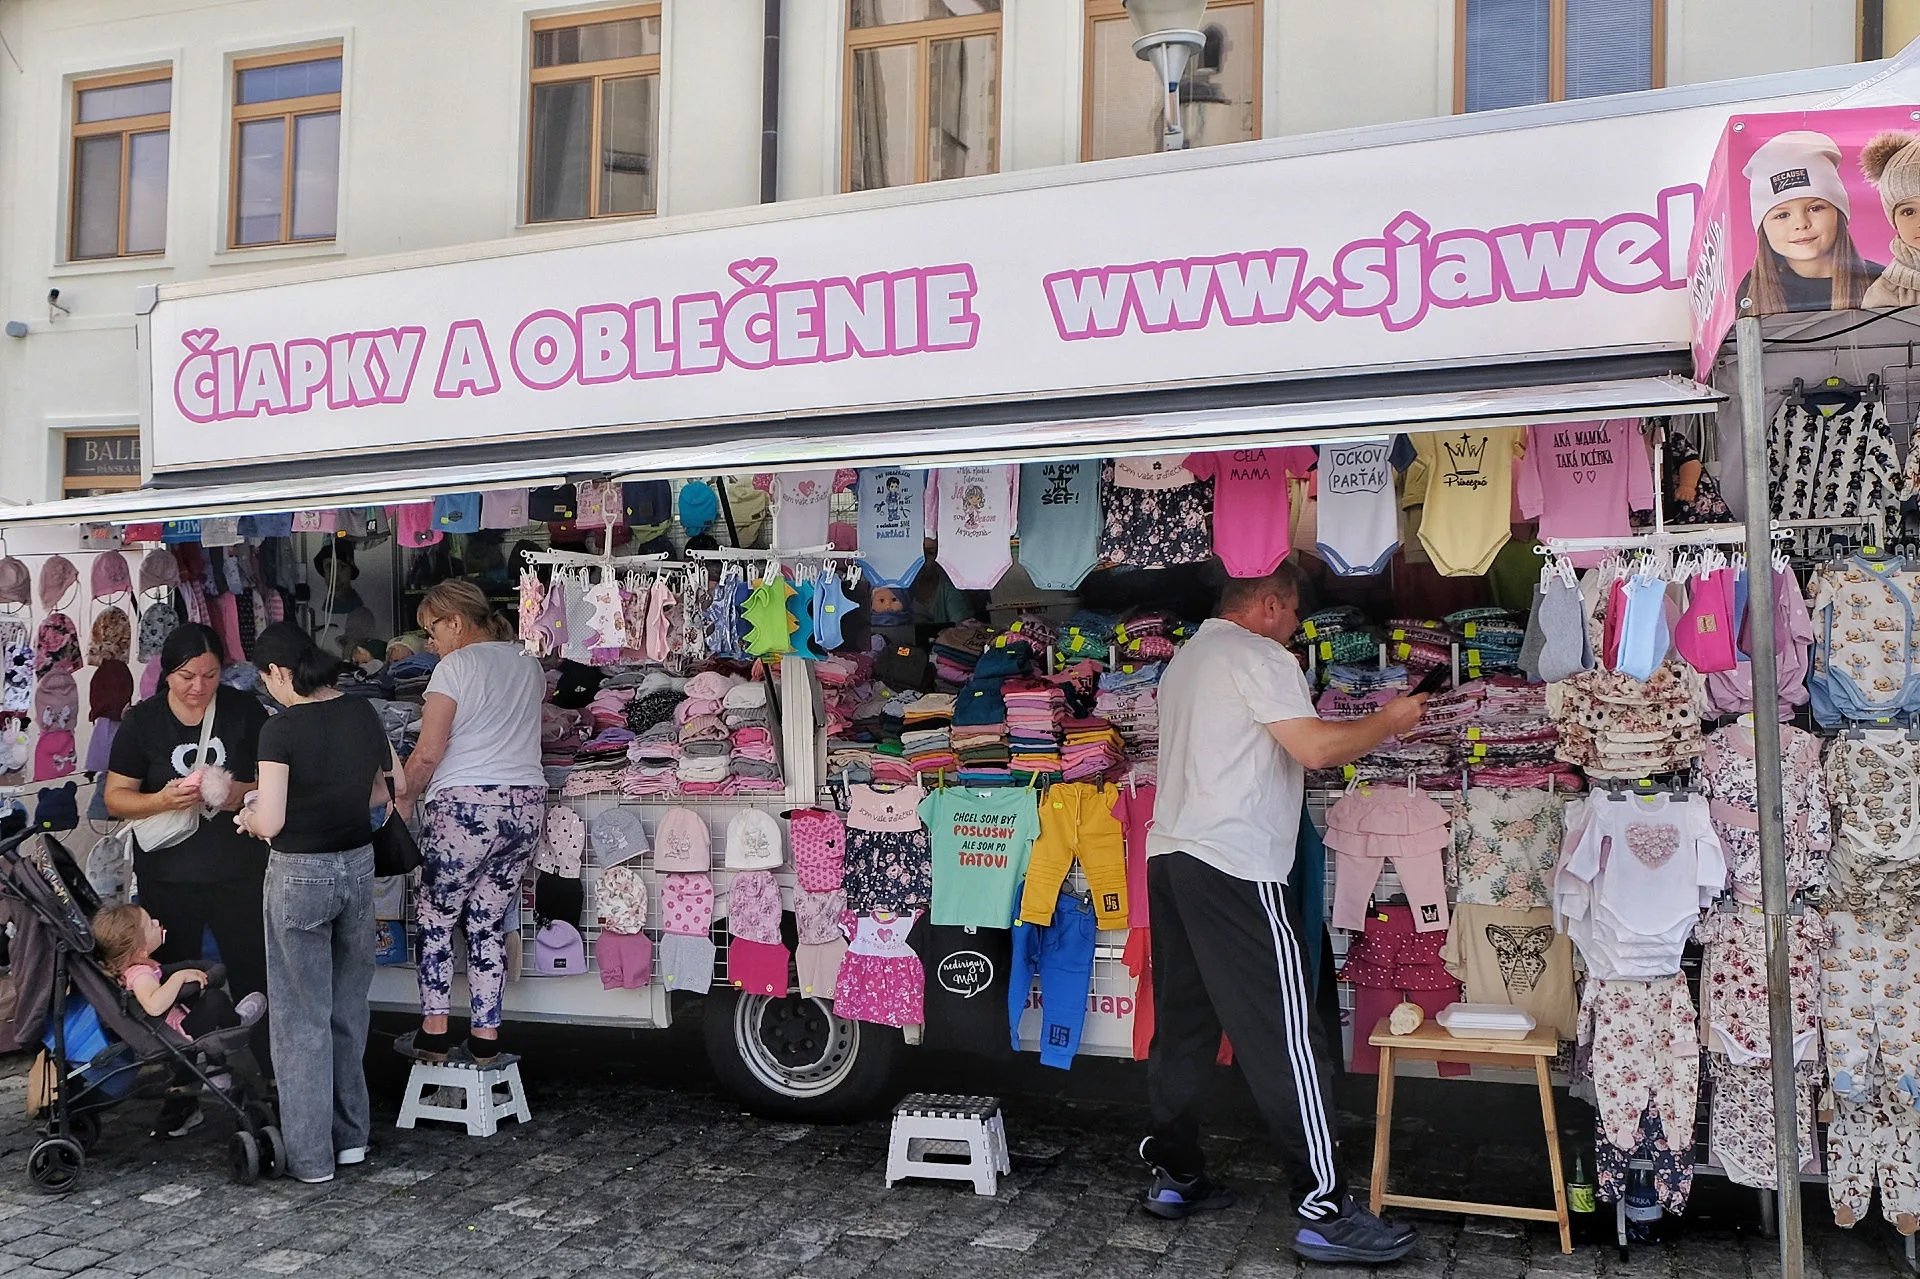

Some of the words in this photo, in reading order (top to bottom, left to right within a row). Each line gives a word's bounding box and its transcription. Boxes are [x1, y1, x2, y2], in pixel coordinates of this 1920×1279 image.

[1772, 169, 1806, 183] BECAUSE
[175, 326, 427, 424] ČIAPKY
[433, 318, 501, 398] A
[510, 256, 980, 391] OBLEČENIE
[1335, 449, 1382, 466] OCKOV
[1042, 465, 1056, 475] JA
[1058, 463, 1080, 475] SOM
[1230, 468, 1271, 480] MAMA
[1333, 467, 1385, 488] PARŤÁK
[1054, 481, 1066, 489] TU
[953, 812, 978, 823] CHCEL
[980, 814, 999, 824] SOM
[953, 824, 1015, 840] POSLUŠNÝ
[962, 841, 976, 850] ALE
[977, 842, 995, 851] SOM
[996, 843, 1007, 852] PO
[958, 852, 1008, 869] TATOVI
[943, 959, 985, 974] nediriguj
